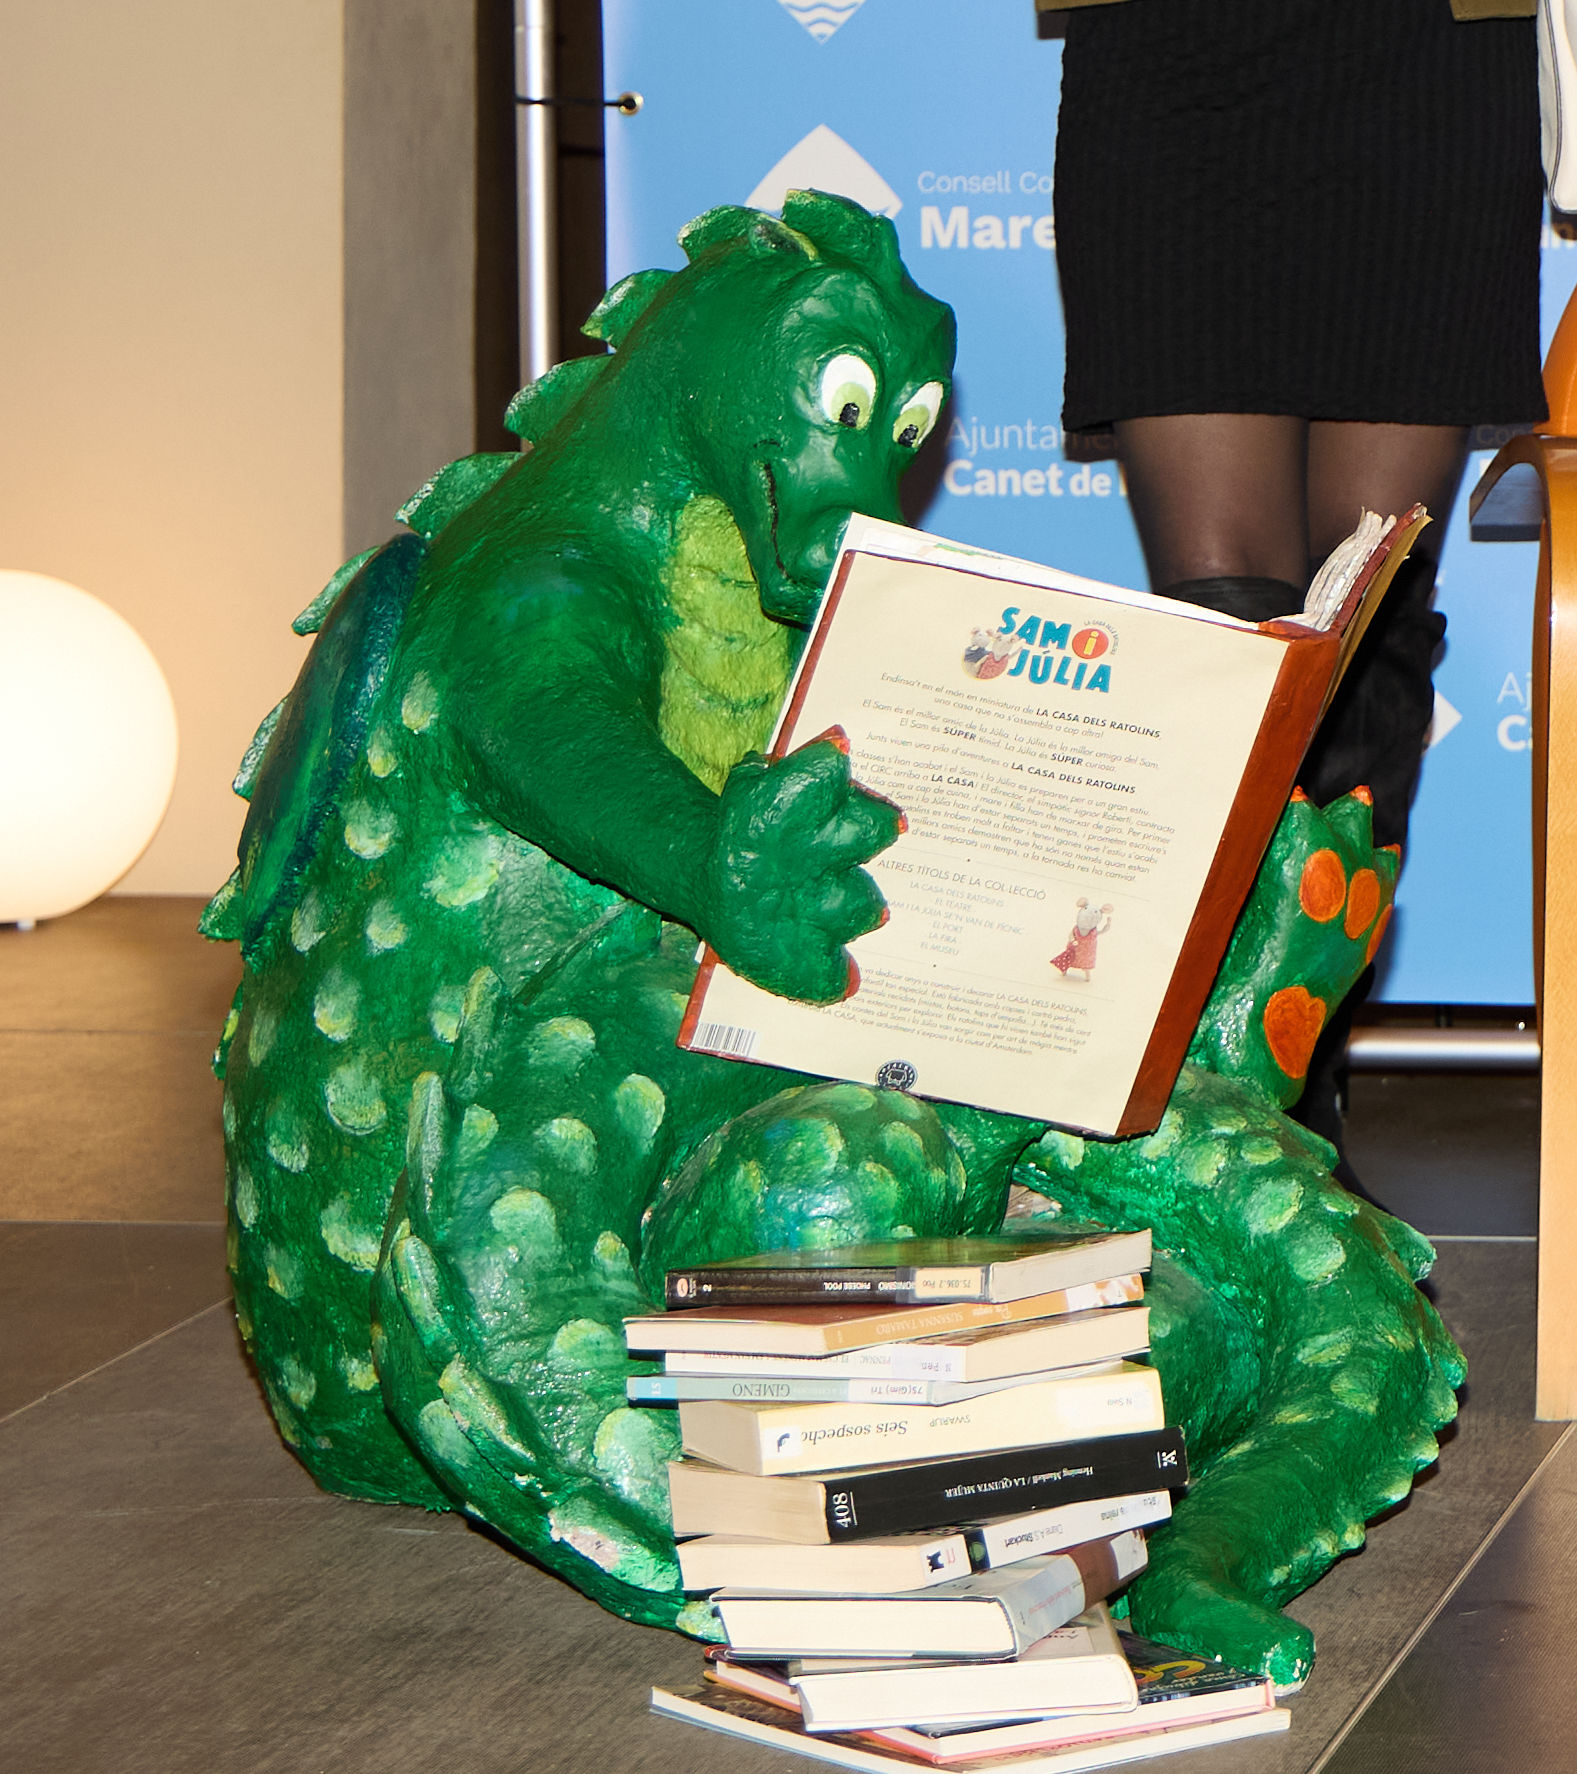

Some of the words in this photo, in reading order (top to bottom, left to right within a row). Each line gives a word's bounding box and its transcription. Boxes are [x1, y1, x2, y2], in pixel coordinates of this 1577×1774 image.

[917, 171, 1012, 194] Consell
[943, 459, 1064, 497] Canet
[1069, 463, 1112, 497] de
[997, 606, 1073, 651] SAM
[1083, 630, 1099, 656] i
[1006, 648, 1112, 694] JÚLIA
[935, 685, 944, 693] el
[1022, 704, 1034, 714] de
[1036, 707, 1049, 717] LA
[1052, 710, 1080, 723] CASA
[1083, 715, 1106, 727] DELS
[899, 717, 908, 727] El
[910, 719, 929, 730] Sam
[943, 724, 977, 740] SÚPER
[1004, 742, 1015, 751] La
[1016, 744, 1037, 757] Júlia
[1050, 750, 1083, 766] SÚPER
[866, 731, 887, 743] Junts
[915, 742, 930, 750] una
[1011, 762, 1024, 771] LA
[1027, 766, 1055, 778] CASA
[1058, 772, 1082, 784] DELS
[877, 857, 913, 873] ALTRES
[916, 863, 950, 880] TÍTOLS
[952, 873, 966, 883] DE
[968, 876, 981, 886] LA
[875, 1318, 917, 1334] TAMARO
[918, 1310, 963, 1327] SUSANNA
[732, 1384, 789, 1396] GIMENO
[875, 1419, 908, 1436] Seis
[928, 1413, 970, 1426] SWARUP
[1013, 1477, 1025, 1486] LA
[1062, 1465, 1093, 1478] Henning
[944, 1484, 975, 1498] MUJER
[976, 1476, 1012, 1492] QUINTA
[832, 1491, 851, 1528] 408
